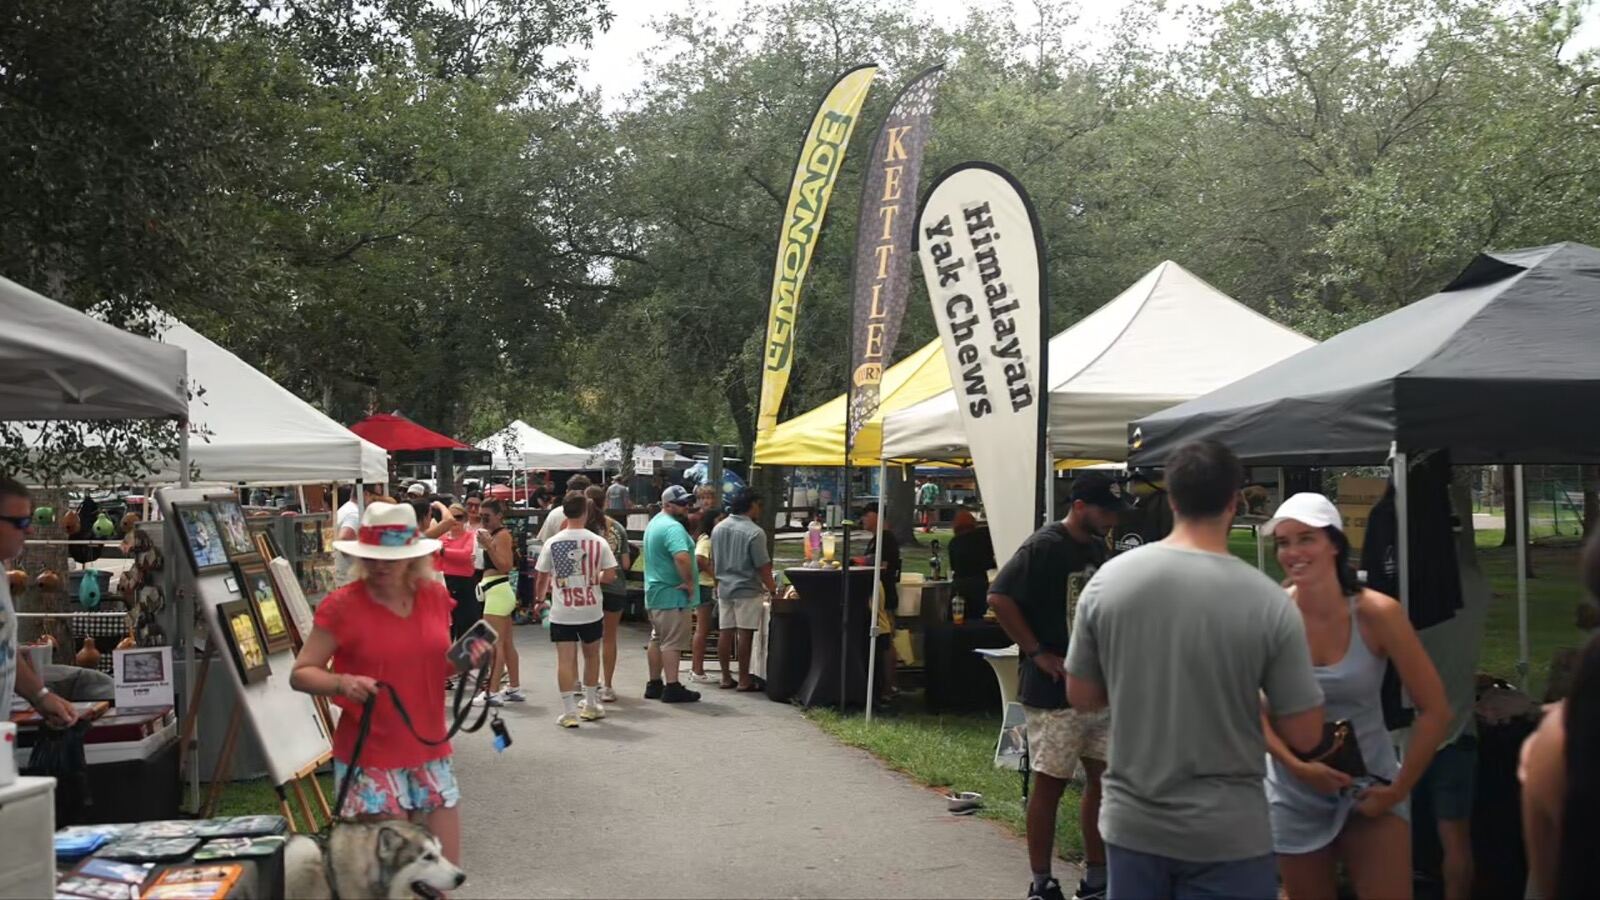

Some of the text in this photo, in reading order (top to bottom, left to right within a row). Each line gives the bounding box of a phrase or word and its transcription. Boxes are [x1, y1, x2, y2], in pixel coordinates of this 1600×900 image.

[864, 126, 912, 358] KETTLE
[925, 214, 992, 419] Yak Chews
[963, 201, 1034, 413] Himalayan
[562, 586, 597, 607] USA
